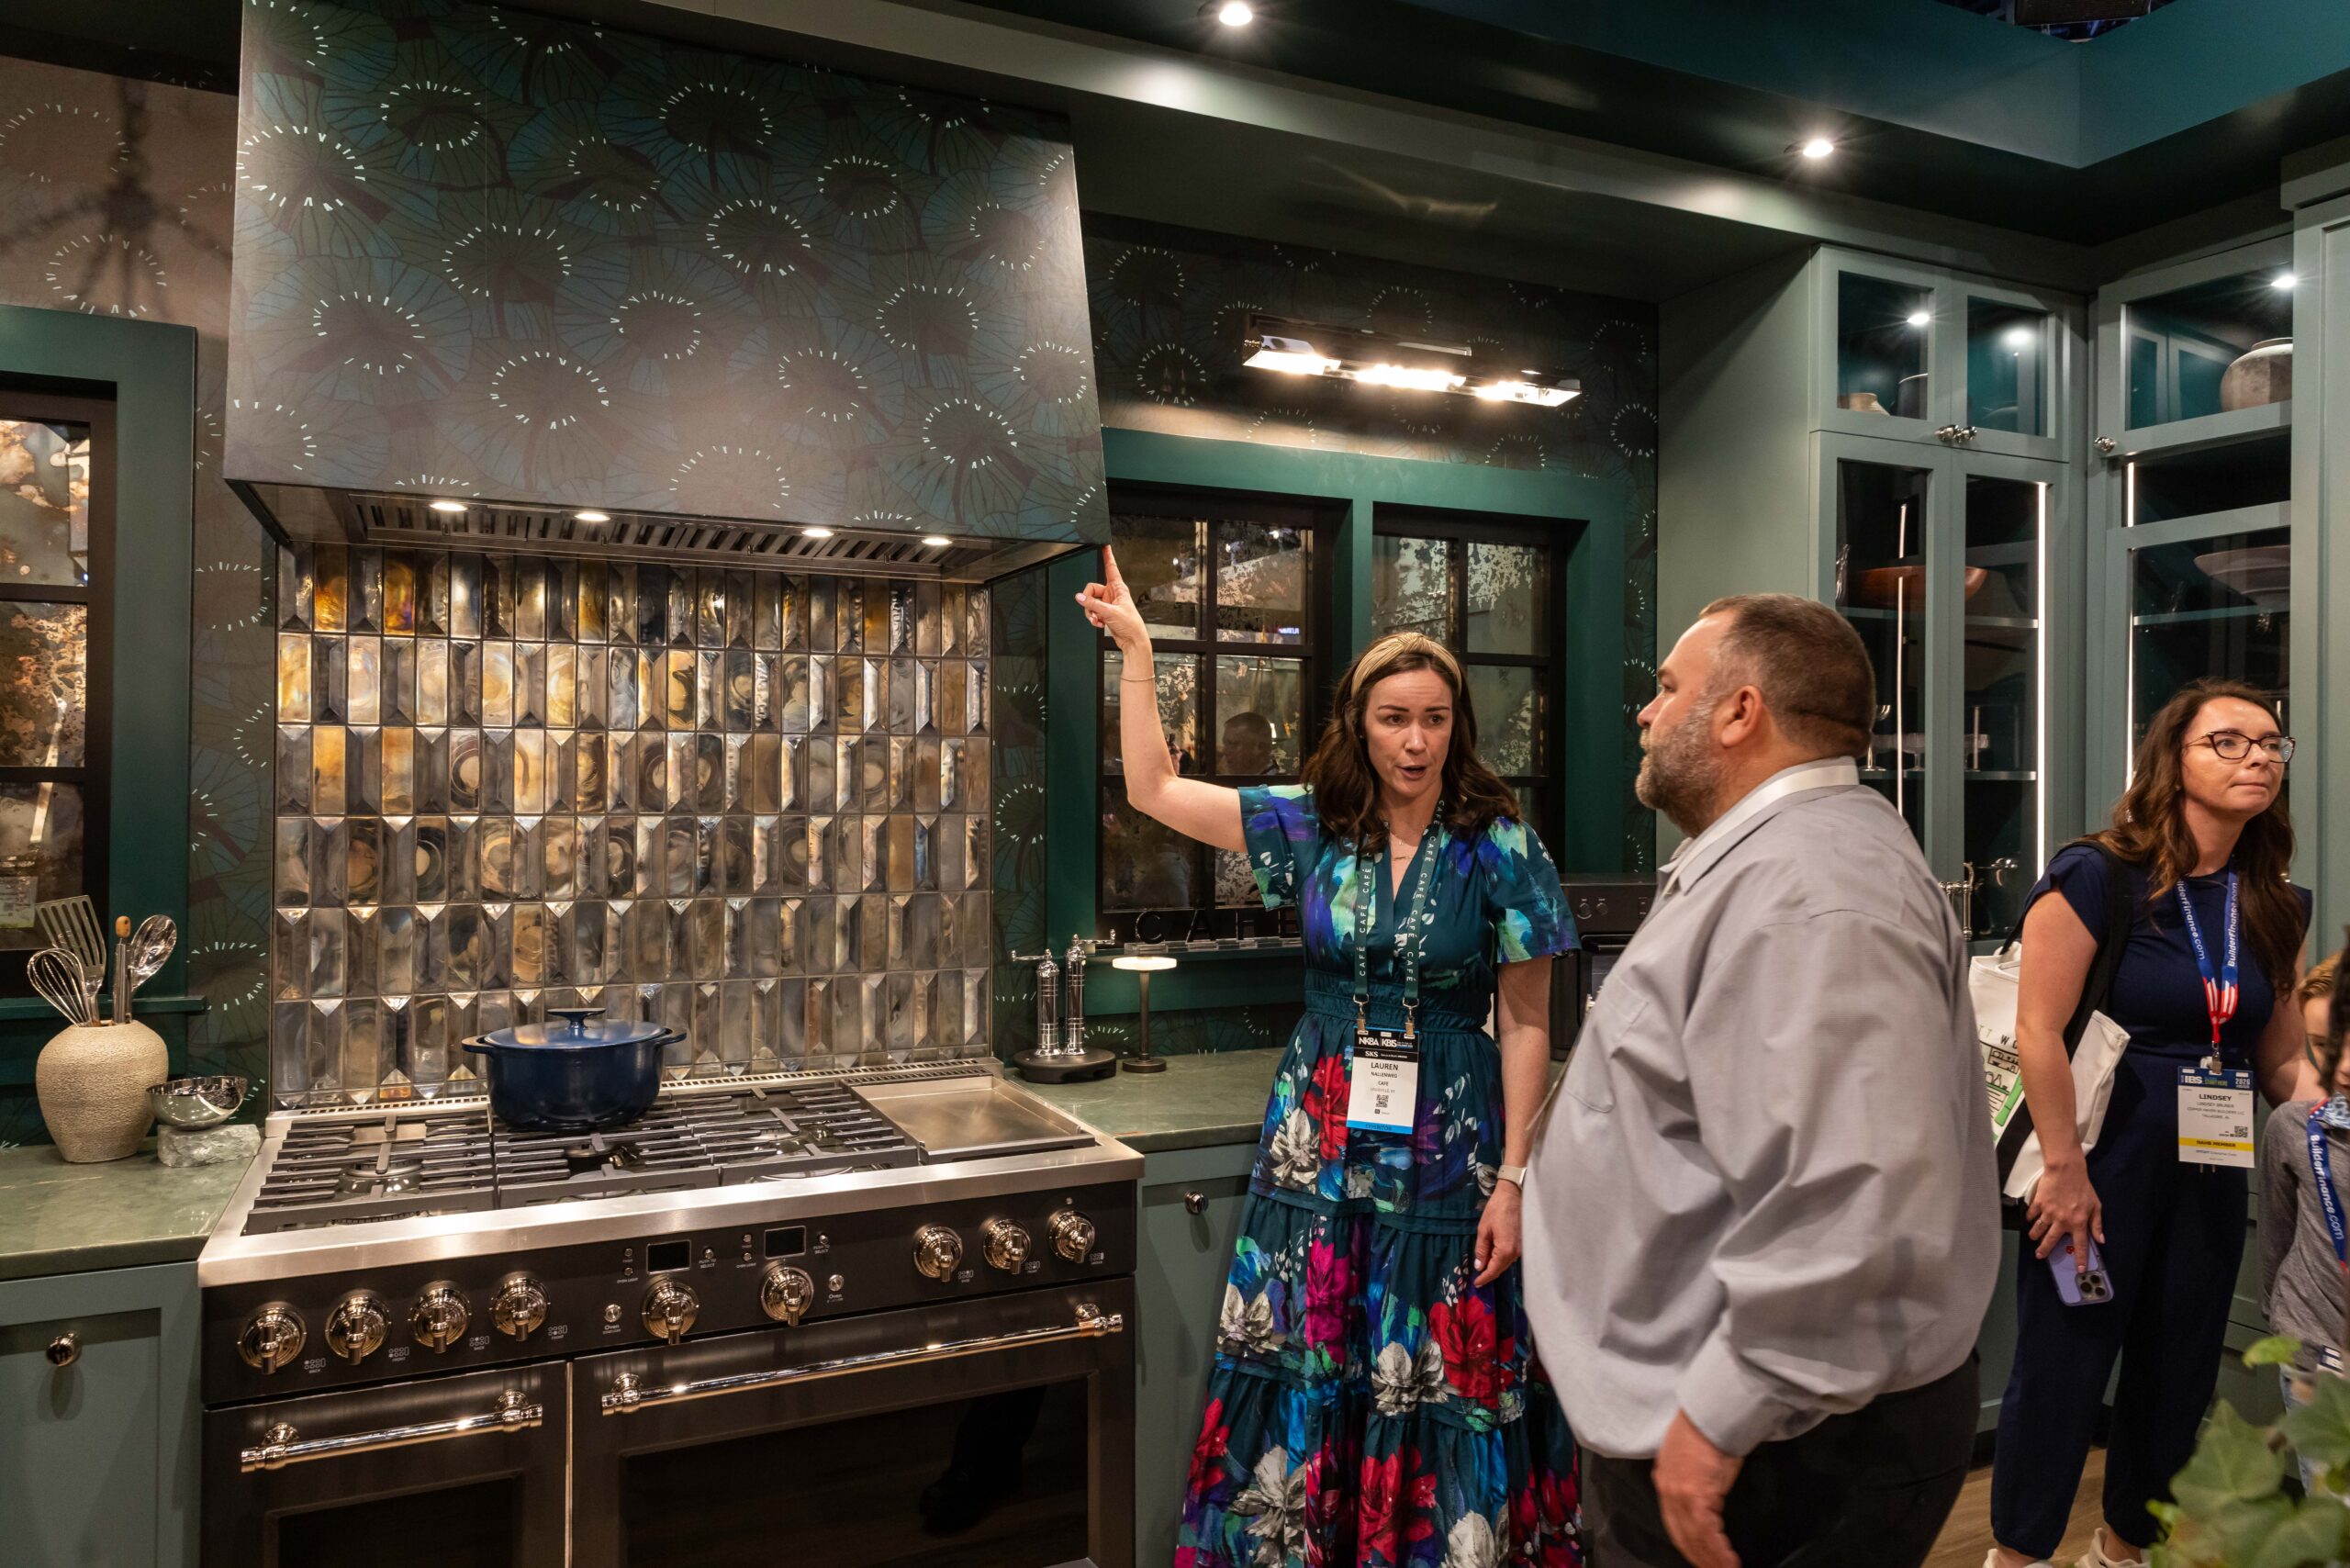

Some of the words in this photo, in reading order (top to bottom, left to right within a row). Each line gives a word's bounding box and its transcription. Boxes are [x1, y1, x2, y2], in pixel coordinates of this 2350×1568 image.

[1425, 835, 1437, 862] CAFÉ
[1361, 868, 1371, 893] CAFÉ
[1416, 872, 1427, 899] CAFÉ
[1358, 904, 1368, 934] CAFÉ
[1408, 910, 1417, 938] CAFÉ
[2177, 879, 2205, 959] ilderFinance.com
[1356, 946, 1366, 977] CAFÉ
[1406, 951, 1416, 982] CAFÉ
[1359, 1036, 1380, 1047] NKBA
[1382, 1038, 1397, 1047] KBIS
[1371, 1062, 1399, 1070] LAUREN
[2185, 1075, 2203, 1084] IBS
[2310, 1134, 2344, 1240] BuilderFinance.com
